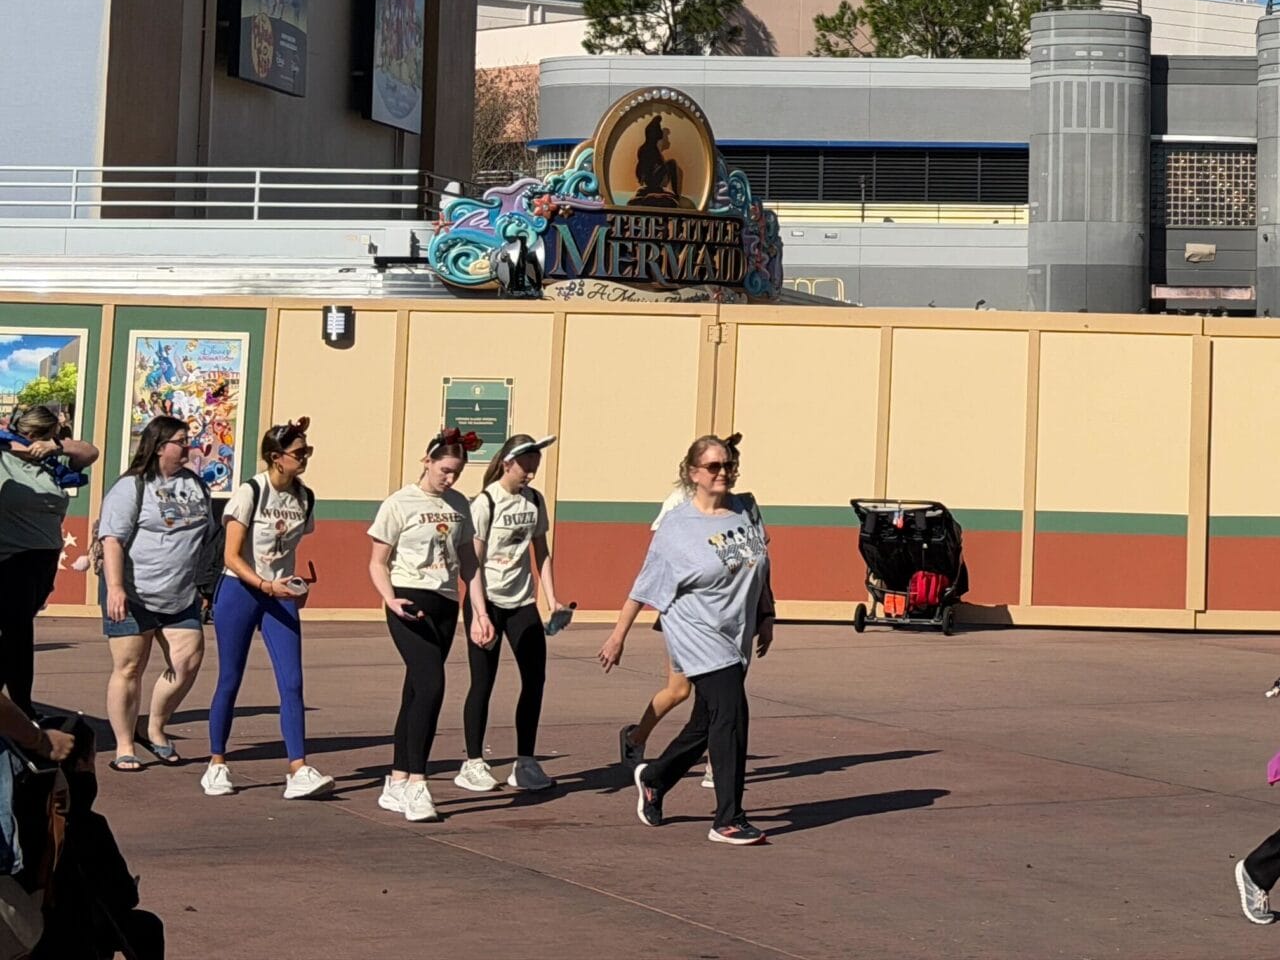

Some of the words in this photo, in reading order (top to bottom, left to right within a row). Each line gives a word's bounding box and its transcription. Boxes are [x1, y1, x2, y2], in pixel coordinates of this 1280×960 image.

[607, 214, 664, 240] THE
[668, 217, 741, 243] LITTLE
[549, 223, 748, 288] MERMAID
[587, 282, 609, 299] A
[261, 508, 304, 521] WOODY
[419, 512, 462, 524] JESSIE
[503, 511, 536, 526] BUZZ
